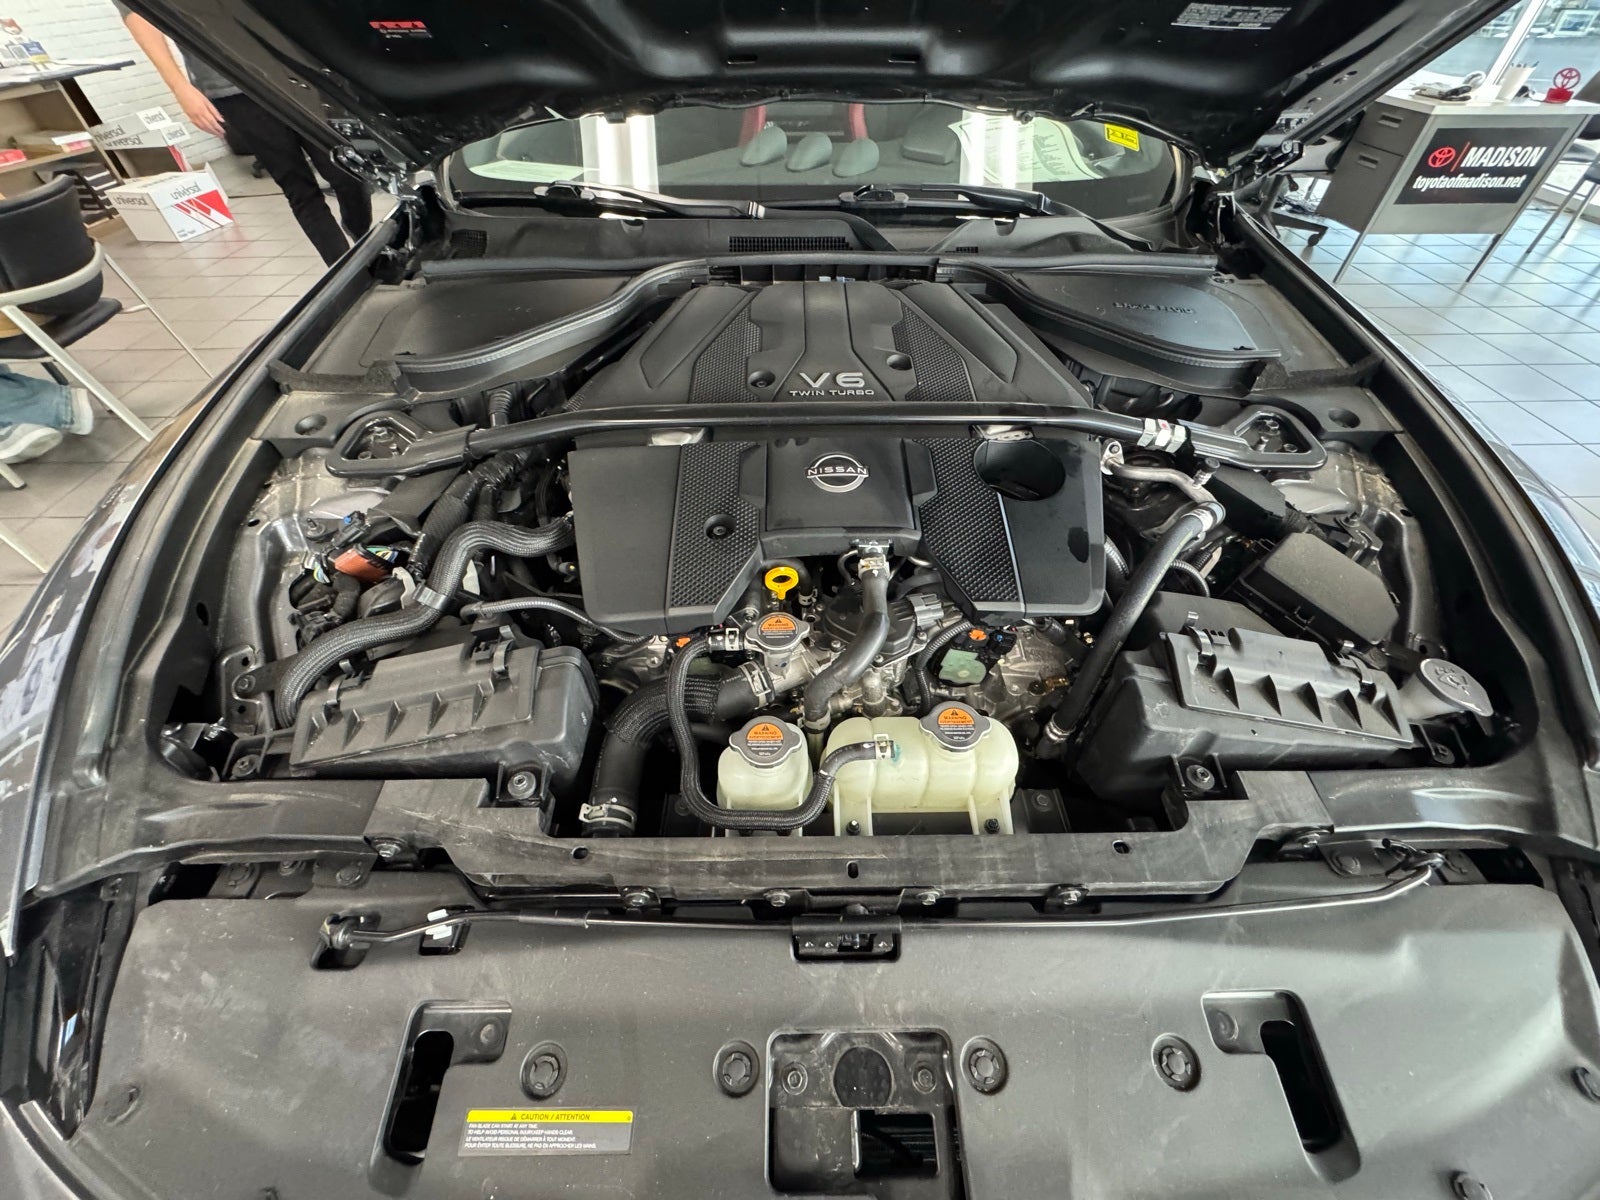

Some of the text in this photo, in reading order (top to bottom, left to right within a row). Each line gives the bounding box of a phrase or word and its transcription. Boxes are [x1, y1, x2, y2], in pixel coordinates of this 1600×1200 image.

[1460, 146, 1548, 168] MADISON
[1412, 172, 1528, 193] toyotaofmadison.net
[170, 181, 202, 200] universal
[113, 194, 149, 206] universal
[799, 371, 866, 388] V6
[789, 388, 875, 397] TWIN TURBO
[807, 465, 868, 476] NISSAN
[520, 1113, 549, 1121] CAUTION
[555, 1113, 591, 1121] ATTENTION
